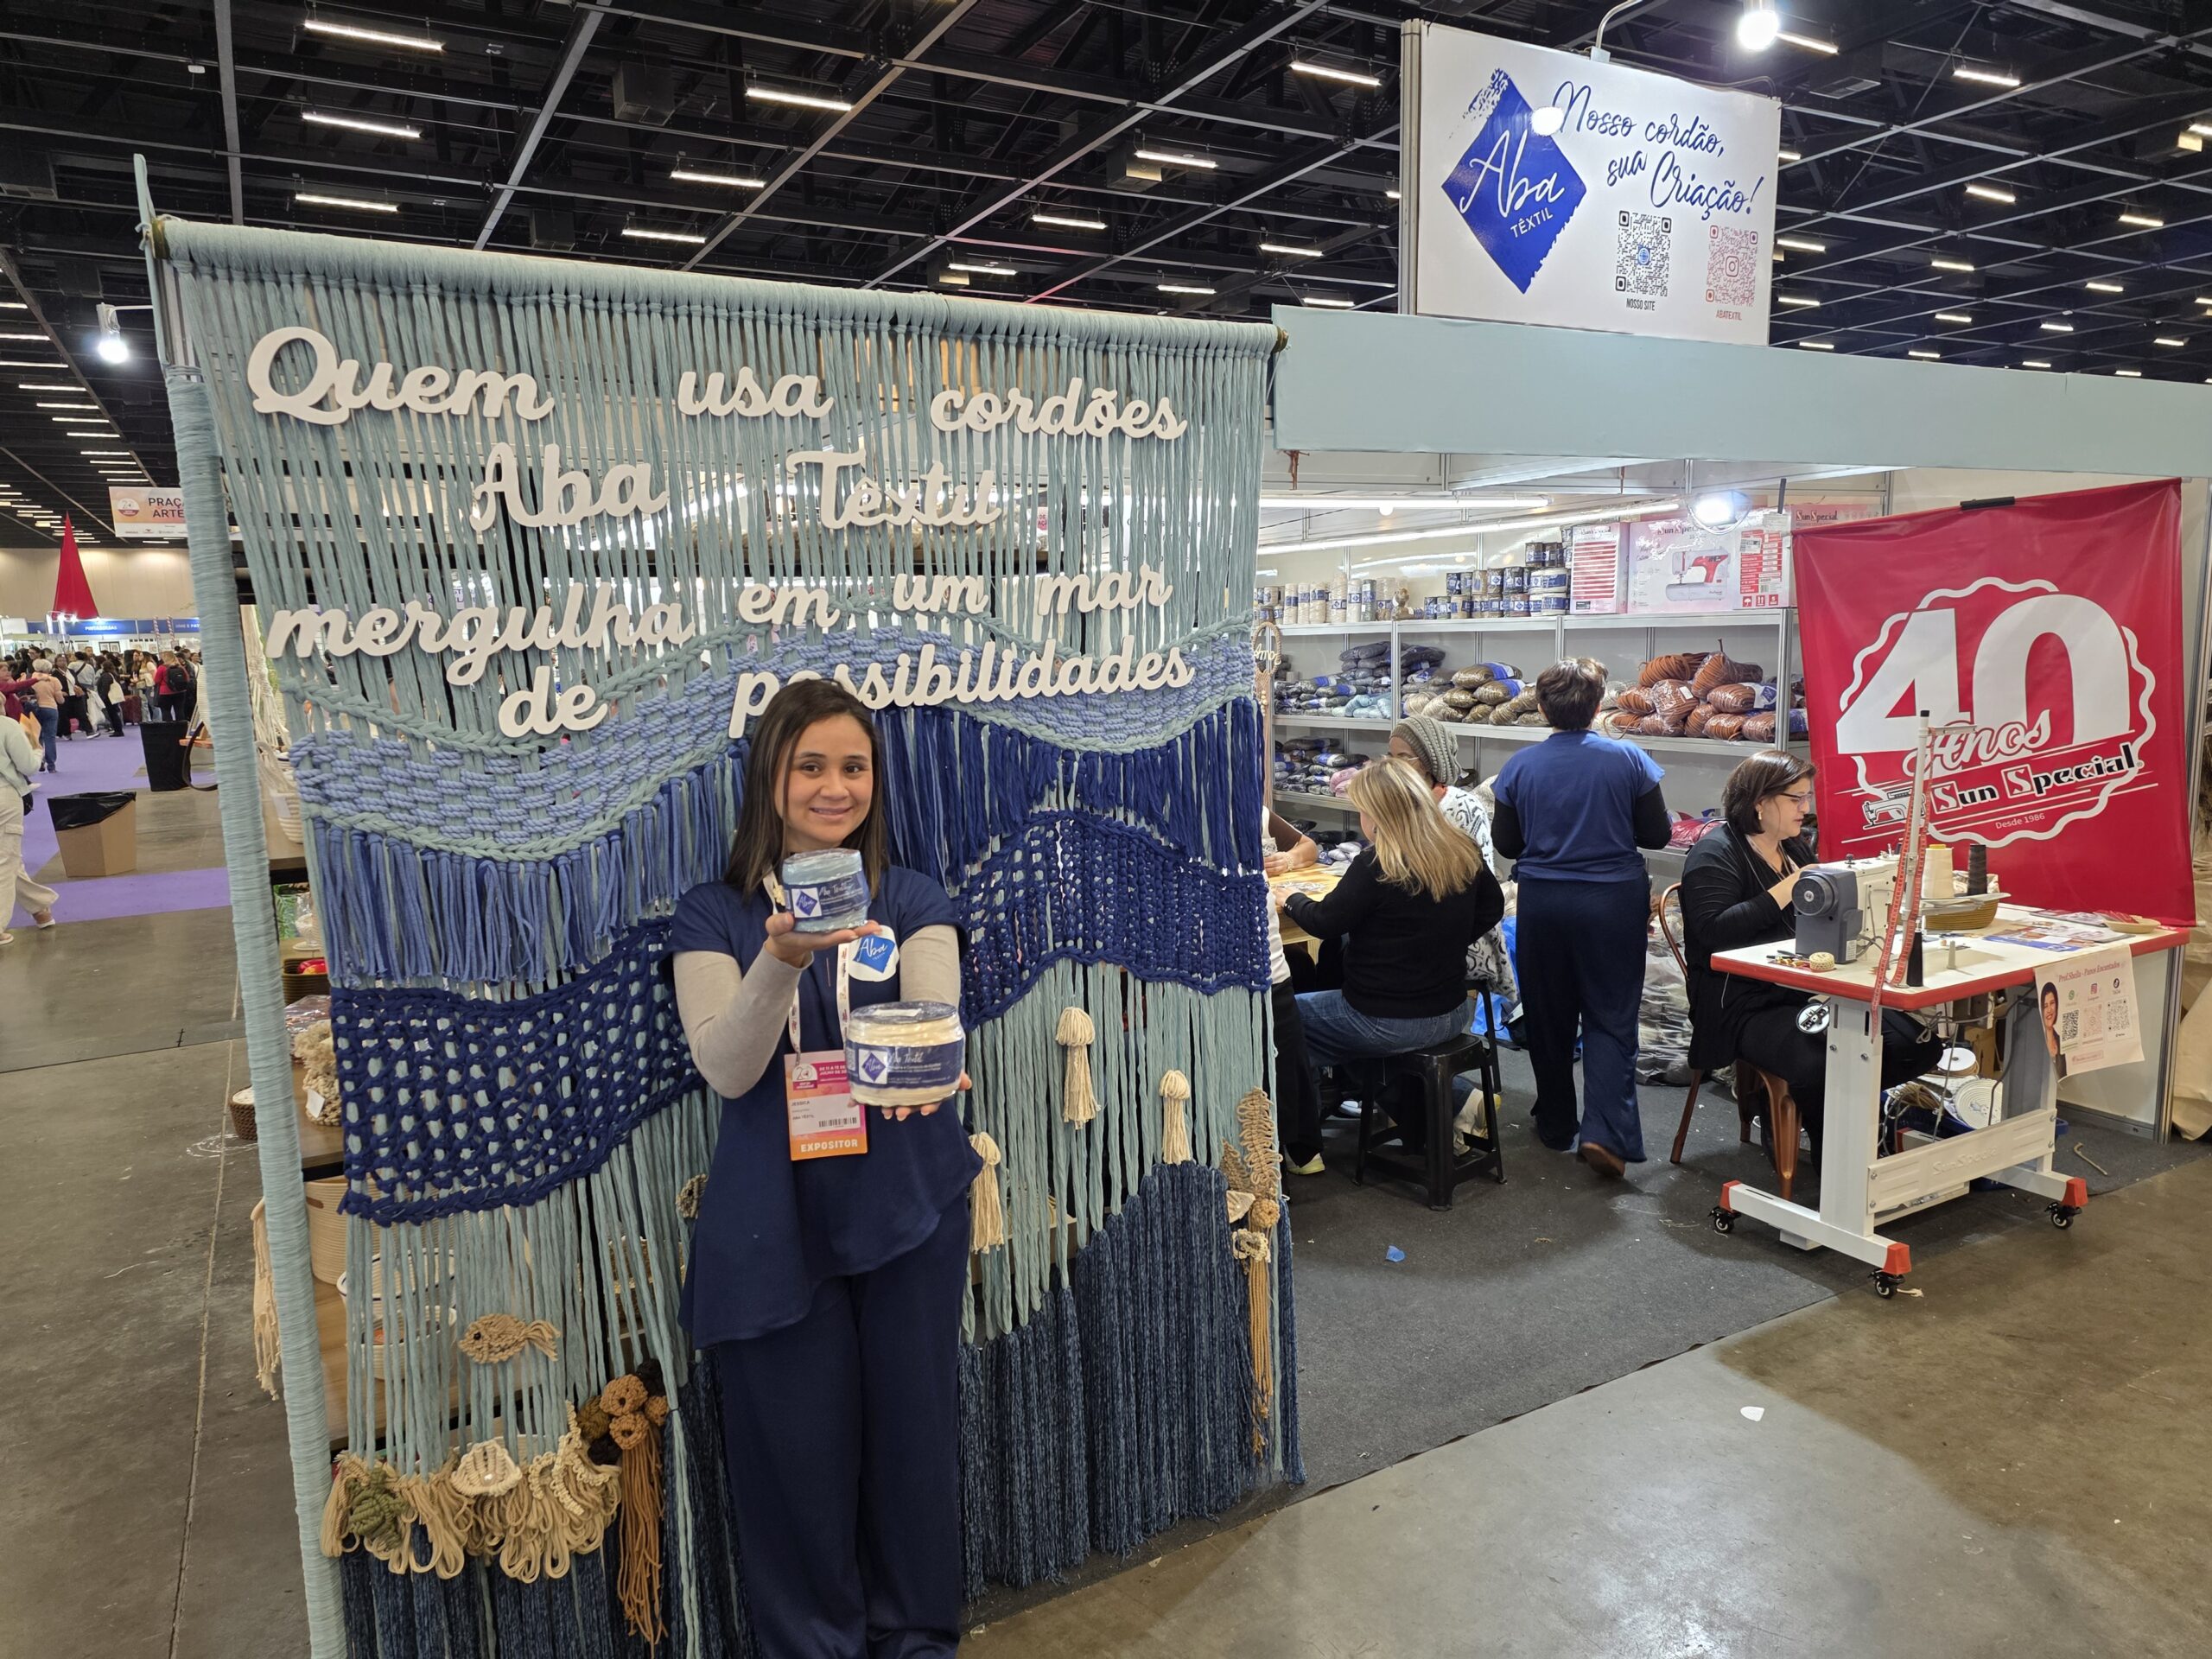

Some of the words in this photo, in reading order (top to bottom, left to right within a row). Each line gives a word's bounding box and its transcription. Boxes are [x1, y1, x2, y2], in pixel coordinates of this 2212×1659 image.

[1552, 81, 1637, 137] Nosso
[1644, 113, 1725, 157] cordão,
[1459, 130, 1565, 218] Aba
[1607, 150, 1648, 187] sua
[1650, 150, 1764, 221] Criação!
[1510, 207, 1554, 238] TÊXTIL
[1626, 298, 1643, 310] NOSSO
[1643, 300, 1656, 311] SITE
[1715, 309, 1742, 321] ABATEXTIL
[247, 327, 555, 425] Quem
[677, 366, 835, 418] usa
[930, 378, 1187, 441] cordões
[148, 498, 184, 510] PRAÇ
[470, 442, 670, 532] Aba
[786, 449, 1001, 529] Têxtil
[266, 582, 696, 686] mergulha
[738, 583, 840, 627] em
[893, 573, 988, 614] um
[1037, 563, 1173, 616] mar
[498, 665, 608, 738] de
[728, 635, 1195, 738] psibilidades
[1835, 594, 2132, 777] 40
[1903, 709, 2050, 779] Anos
[1932, 783, 1998, 812] Sun
[2003, 743, 2135, 795] Special
[1995, 818, 2023, 830] Desde
[2024, 813, 2045, 823] 1986
[856, 936, 888, 963] Aba
[800, 1139, 858, 1153] EXPOSITOR
